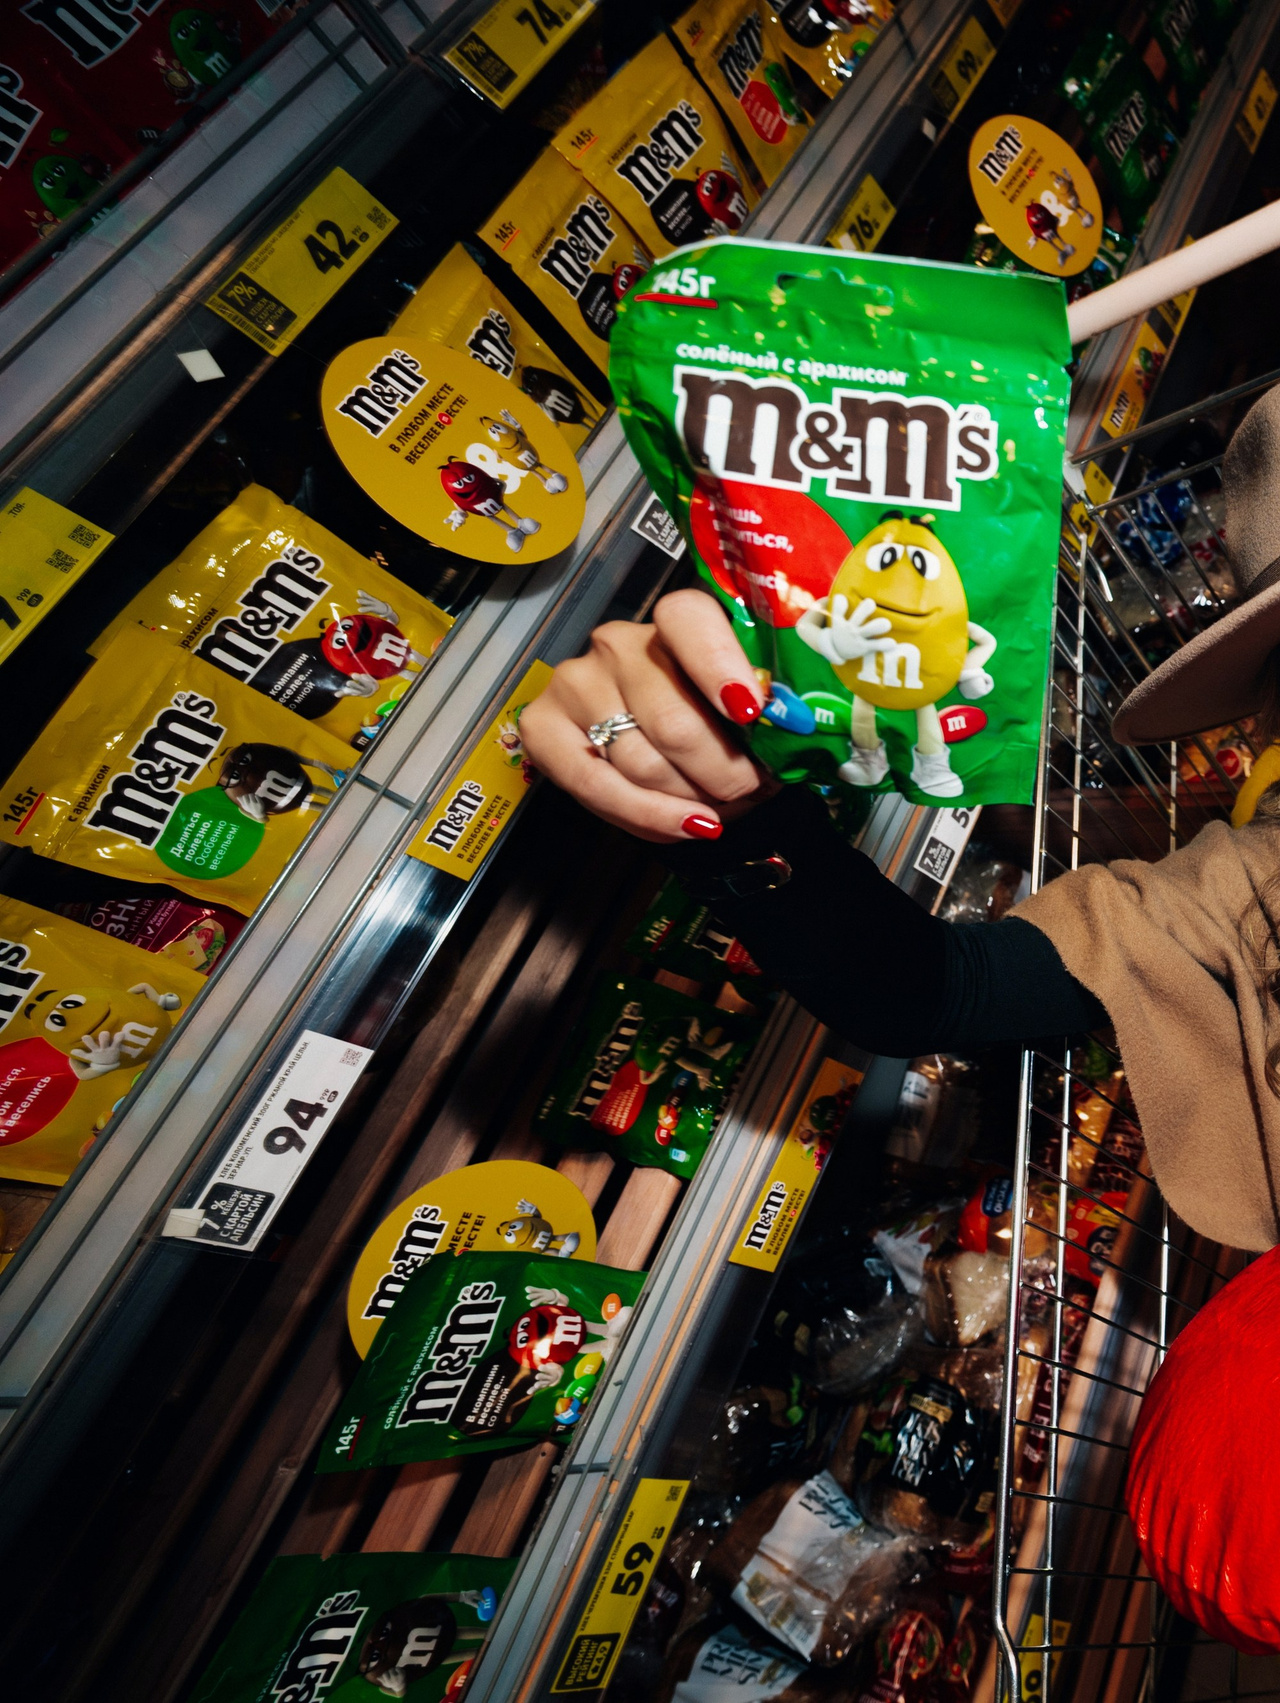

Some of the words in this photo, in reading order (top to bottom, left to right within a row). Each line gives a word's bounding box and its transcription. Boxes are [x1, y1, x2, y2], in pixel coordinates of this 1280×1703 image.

[516, 0, 565, 45] 74
[570, 128, 597, 151] 145г
[617, 100, 705, 208] m&m's
[978, 125, 1024, 185] m&m's
[304, 220, 360, 274] 42
[496, 221, 518, 245] 145г
[539, 194, 618, 300] m&m's
[226, 280, 258, 307] 7%
[676, 342, 780, 373] солёный
[782, 360, 795, 374] с
[798, 361, 909, 387] арахисом
[335, 349, 429, 438] m&m's
[389, 444, 400, 454] В
[398, 409, 431, 447] ЛЮБОМ
[428, 383, 455, 415] МЕСТЕ
[674, 365, 999, 512] m&m's
[404, 428, 438, 465] ВЕСЕЛЕЕ
[180, 607, 219, 650] рахисом
[192, 546, 333, 683] m&m's
[269, 653, 309, 696] компании
[294, 681, 316, 704] мной
[83, 690, 227, 850] m&m's
[3, 787, 40, 825] 145г
[68, 814, 77, 823] с
[75, 764, 111, 817] арахисом
[170, 812, 202, 857] Делиться
[425, 781, 486, 853] m&m's
[457, 852, 464, 860] В
[462, 820, 485, 854] ЛЮБОМ
[484, 794, 503, 822] МЕСТЕ
[951, 807, 975, 829] 5
[184, 820, 213, 861] полезно.
[195, 821, 226, 865] Особенно
[209, 823, 240, 870] весельем!
[467, 831, 492, 865] ВЕСЕЛЕЕ
[0, 1066, 26, 1096] ться,
[5, 1075, 52, 1127] веселись
[218, 1158, 233, 1179] ХЛЕБ
[229, 1115, 261, 1161] КОЛОМЕНСКИЙ
[269, 1075, 287, 1103] РЖАНОЙ
[284, 1057, 297, 1077] КРАЙ
[263, 1098, 328, 1155] 94
[220, 1189, 242, 1216] КЕШБЭК
[224, 1193, 254, 1233] КАРТОЙ
[230, 1193, 267, 1243] АПЕЛЬСИН
[743, 1181, 788, 1252] m&m's
[785, 1188, 800, 1213] МЕСТЕ
[220, 1227, 231, 1238] С
[447, 1211, 473, 1252] МЕСТЕ
[457, 1214, 487, 1256] ЕСТЕ!
[773, 1222, 790, 1256] ВЕСЕЛЕЕ
[383, 1386, 411, 1430] солёный
[405, 1376, 414, 1385] с
[410, 1325, 440, 1374] арахисом
[395, 1281, 506, 1429] m&m's
[465, 1415, 476, 1423] В
[472, 1364, 500, 1414] компании
[477, 1375, 506, 1425] веселее...
[487, 1415, 498, 1427] со
[493, 1387, 511, 1414] мной
[335, 1416, 361, 1456] 145г
[611, 1541, 655, 1597] 59
[271, 1590, 369, 1703] &m's
[565, 1639, 591, 1686] ВЫСОКИЙ
[576, 1641, 599, 1683] РЕЙТИНГ
